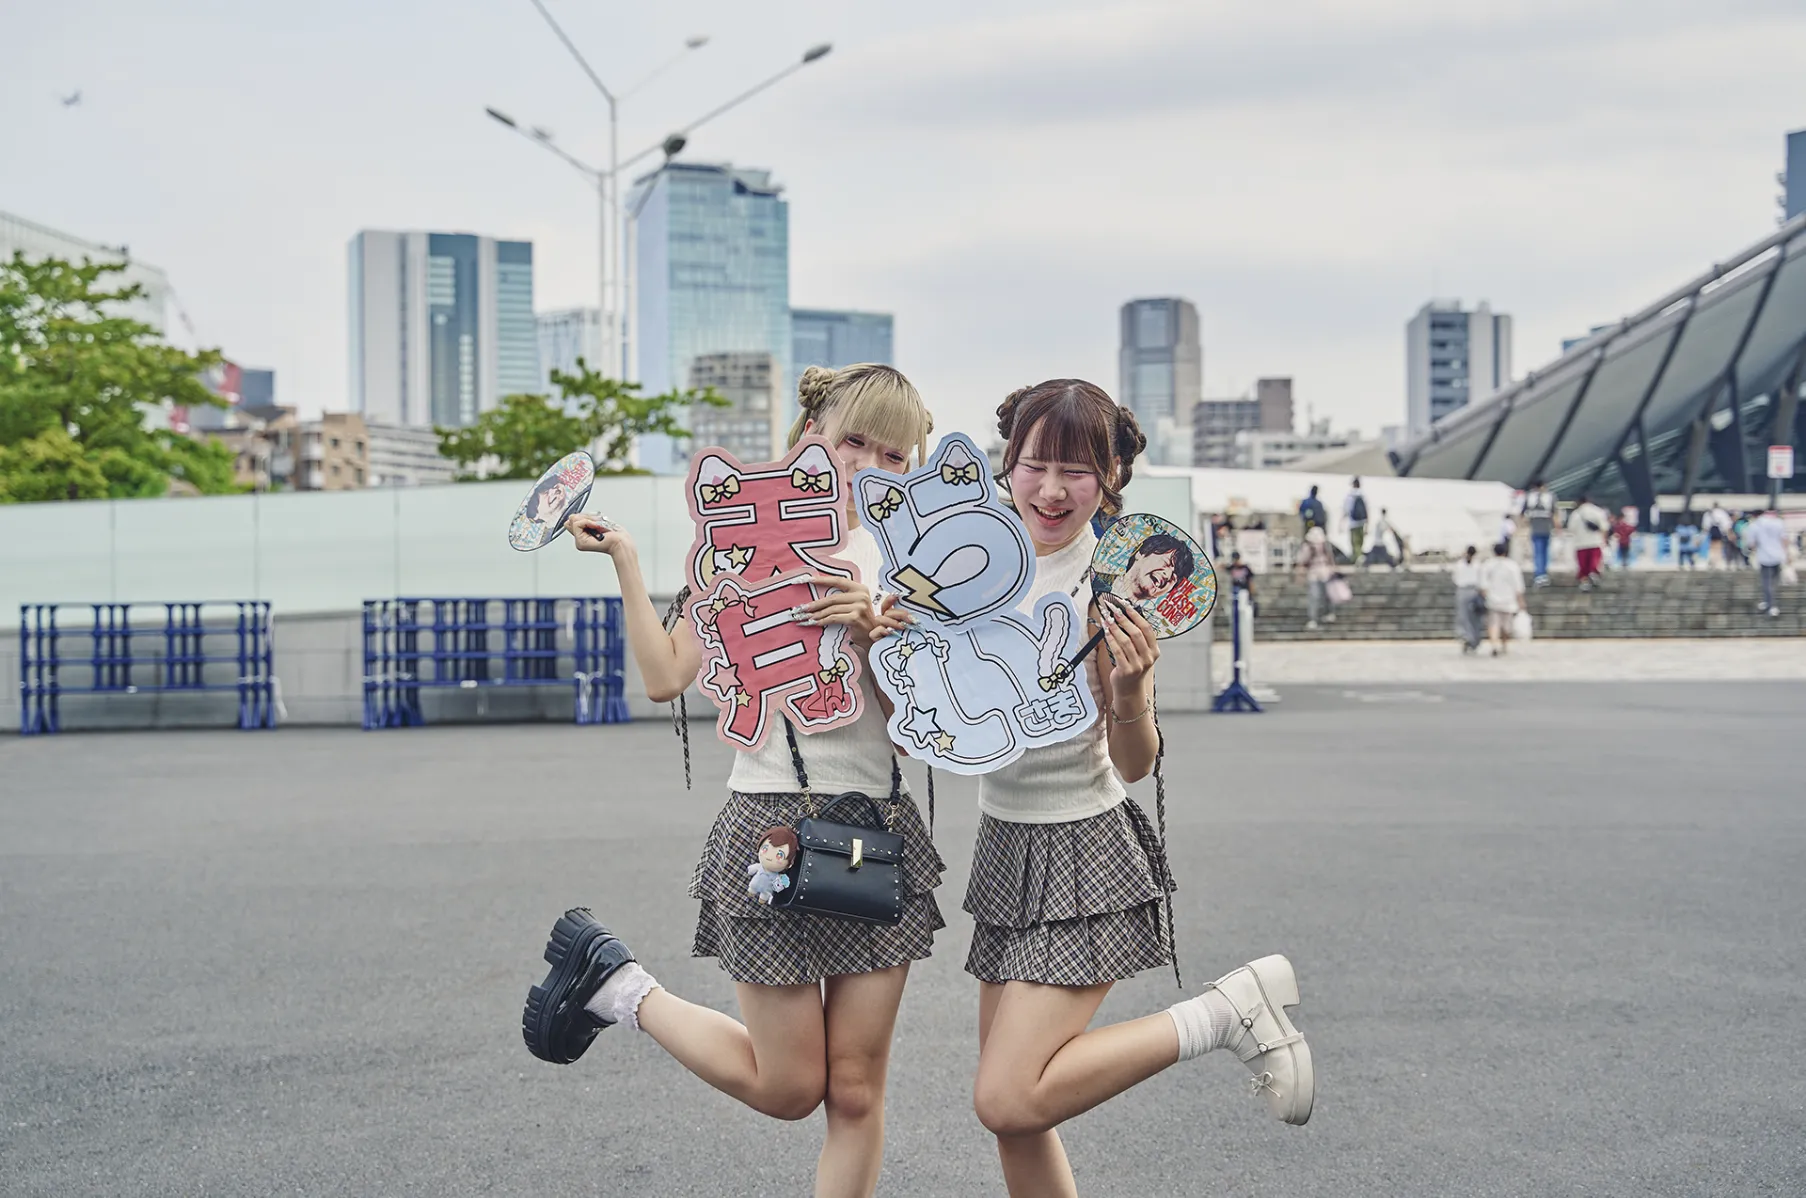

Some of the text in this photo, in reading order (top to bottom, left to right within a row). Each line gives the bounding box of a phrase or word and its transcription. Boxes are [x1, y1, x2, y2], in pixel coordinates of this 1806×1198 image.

[1176, 577, 1197, 596] THE
[1157, 599, 1178, 623] CON
[1166, 587, 1199, 619] K4SEN
[800, 687, 852, 719] くん
[1018, 689, 1081, 732] さま
